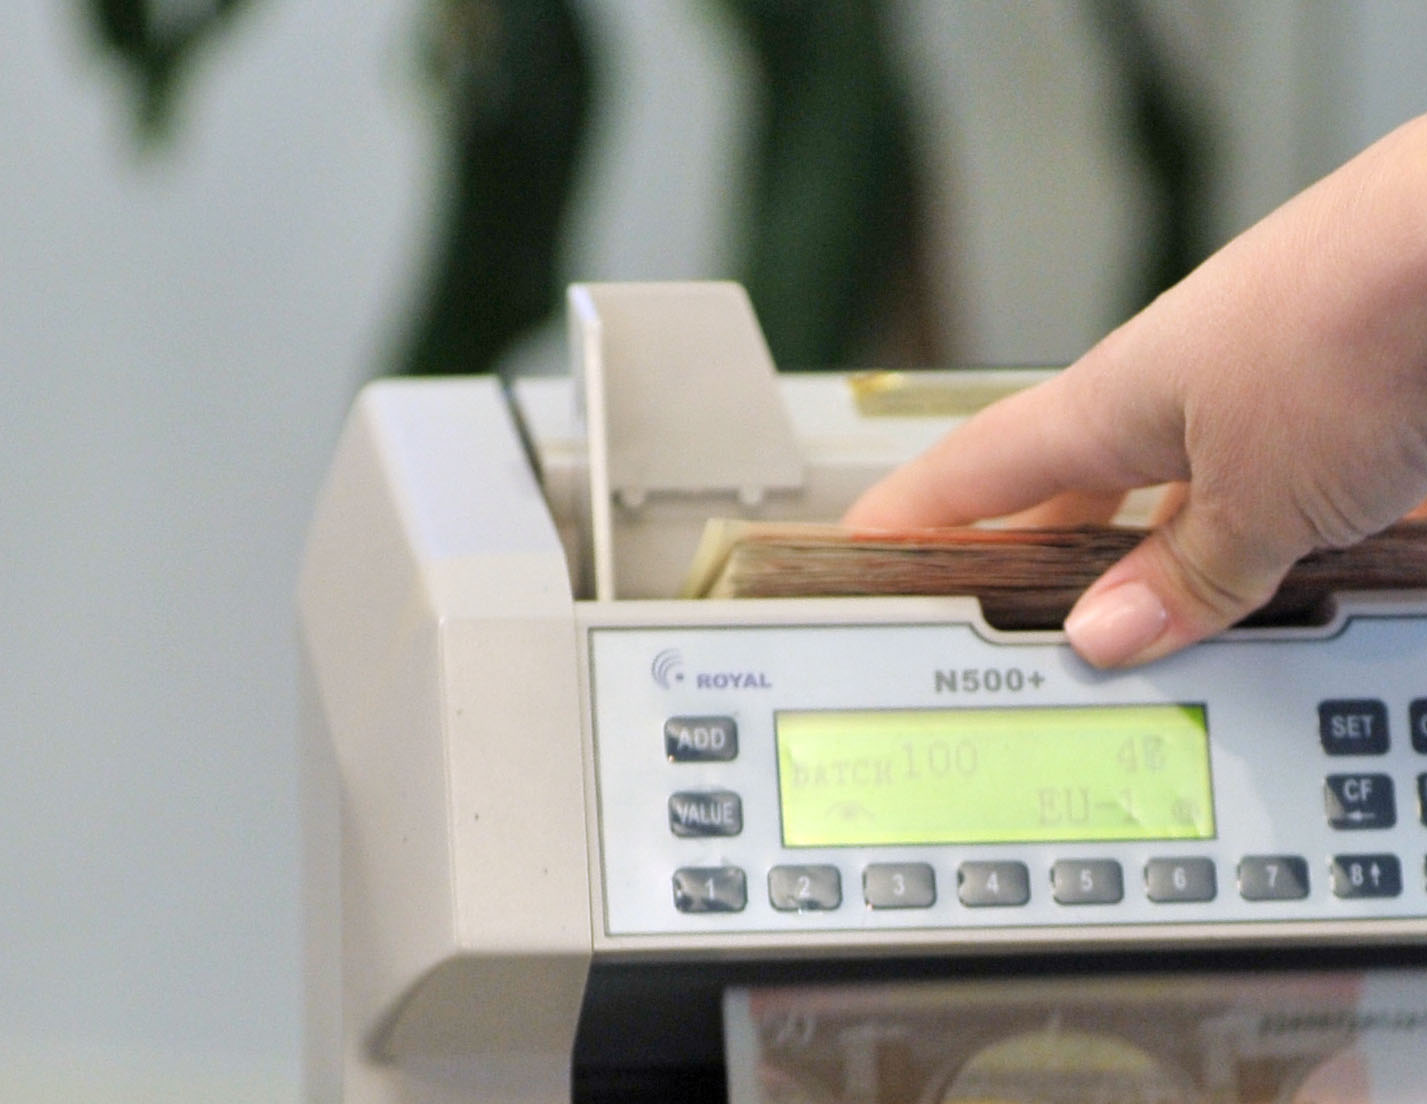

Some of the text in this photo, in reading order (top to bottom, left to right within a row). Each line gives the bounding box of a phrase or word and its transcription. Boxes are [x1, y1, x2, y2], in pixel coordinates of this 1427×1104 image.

[696, 672, 773, 690] ROYAL
[934, 668, 1046, 693] N500+
[1331, 714, 1374, 738] SET
[677, 726, 726, 750] ADD
[900, 739, 980, 780] 100
[1343, 778, 1373, 801] CF
[676, 800, 735, 825] VALUE
[705, 876, 715, 899] 1
[798, 876, 811, 898] 2
[891, 874, 904, 895] 3
[985, 873, 999, 894] 4
[1079, 870, 1092, 892] 5
[1173, 868, 1186, 890] 6
[1266, 866, 1279, 888] 7
